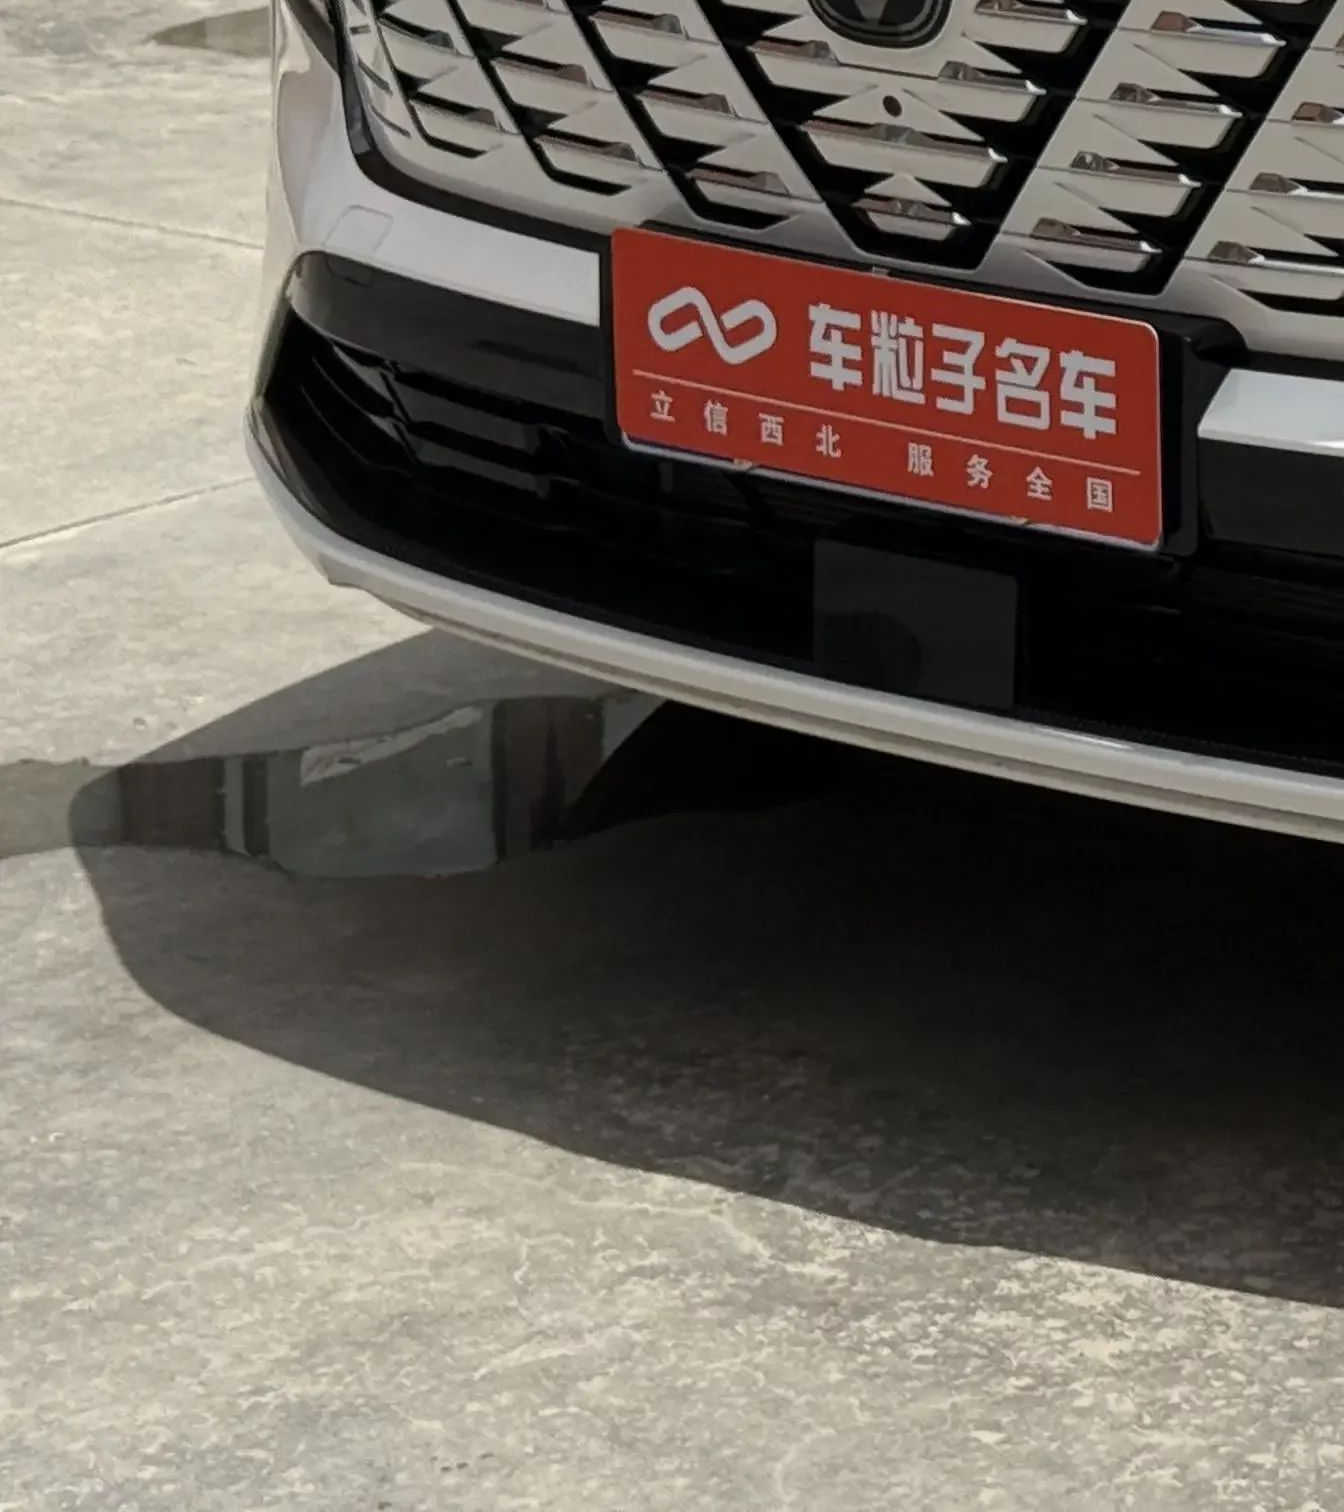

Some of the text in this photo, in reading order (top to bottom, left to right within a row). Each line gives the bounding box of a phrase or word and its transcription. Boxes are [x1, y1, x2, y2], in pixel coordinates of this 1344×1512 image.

[808, 302, 1117, 440] 车粒子名车
[649, 389, 1114, 513] 立信西北 服务全国
